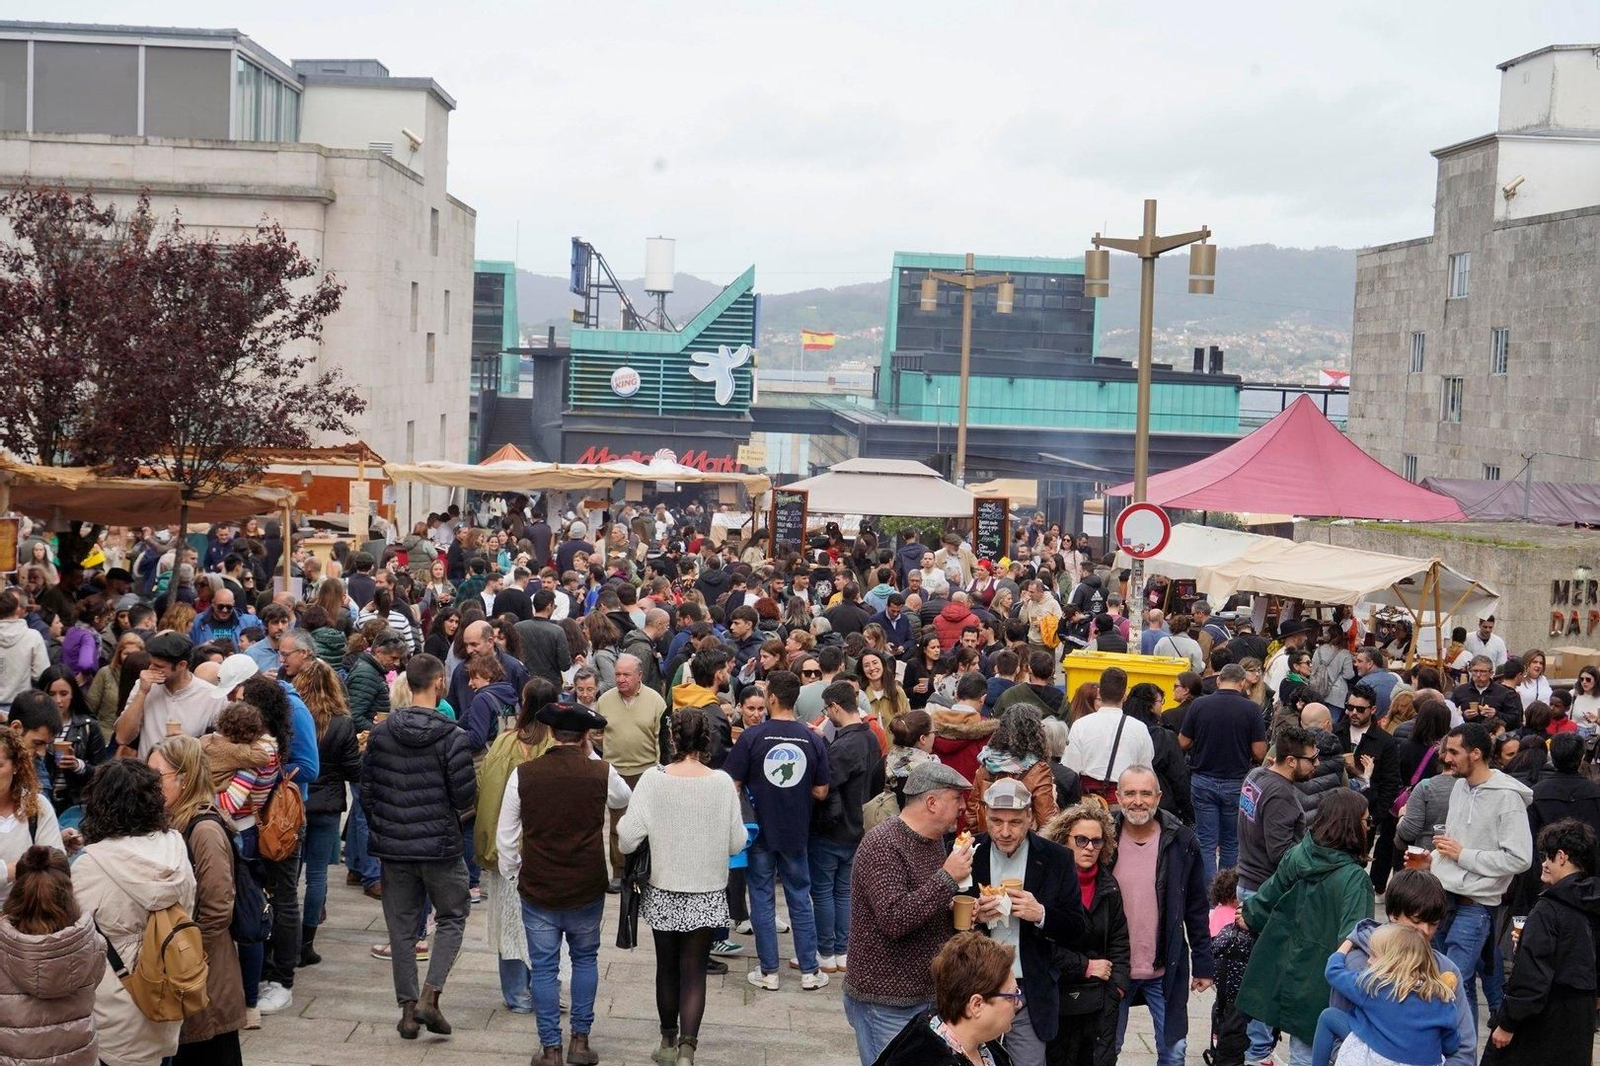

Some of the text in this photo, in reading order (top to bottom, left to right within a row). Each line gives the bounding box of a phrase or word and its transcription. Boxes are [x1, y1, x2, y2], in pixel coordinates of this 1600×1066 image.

[615, 378, 638, 389] KING
[679, 450, 742, 472] Markt
[1551, 580, 1598, 606] MER
